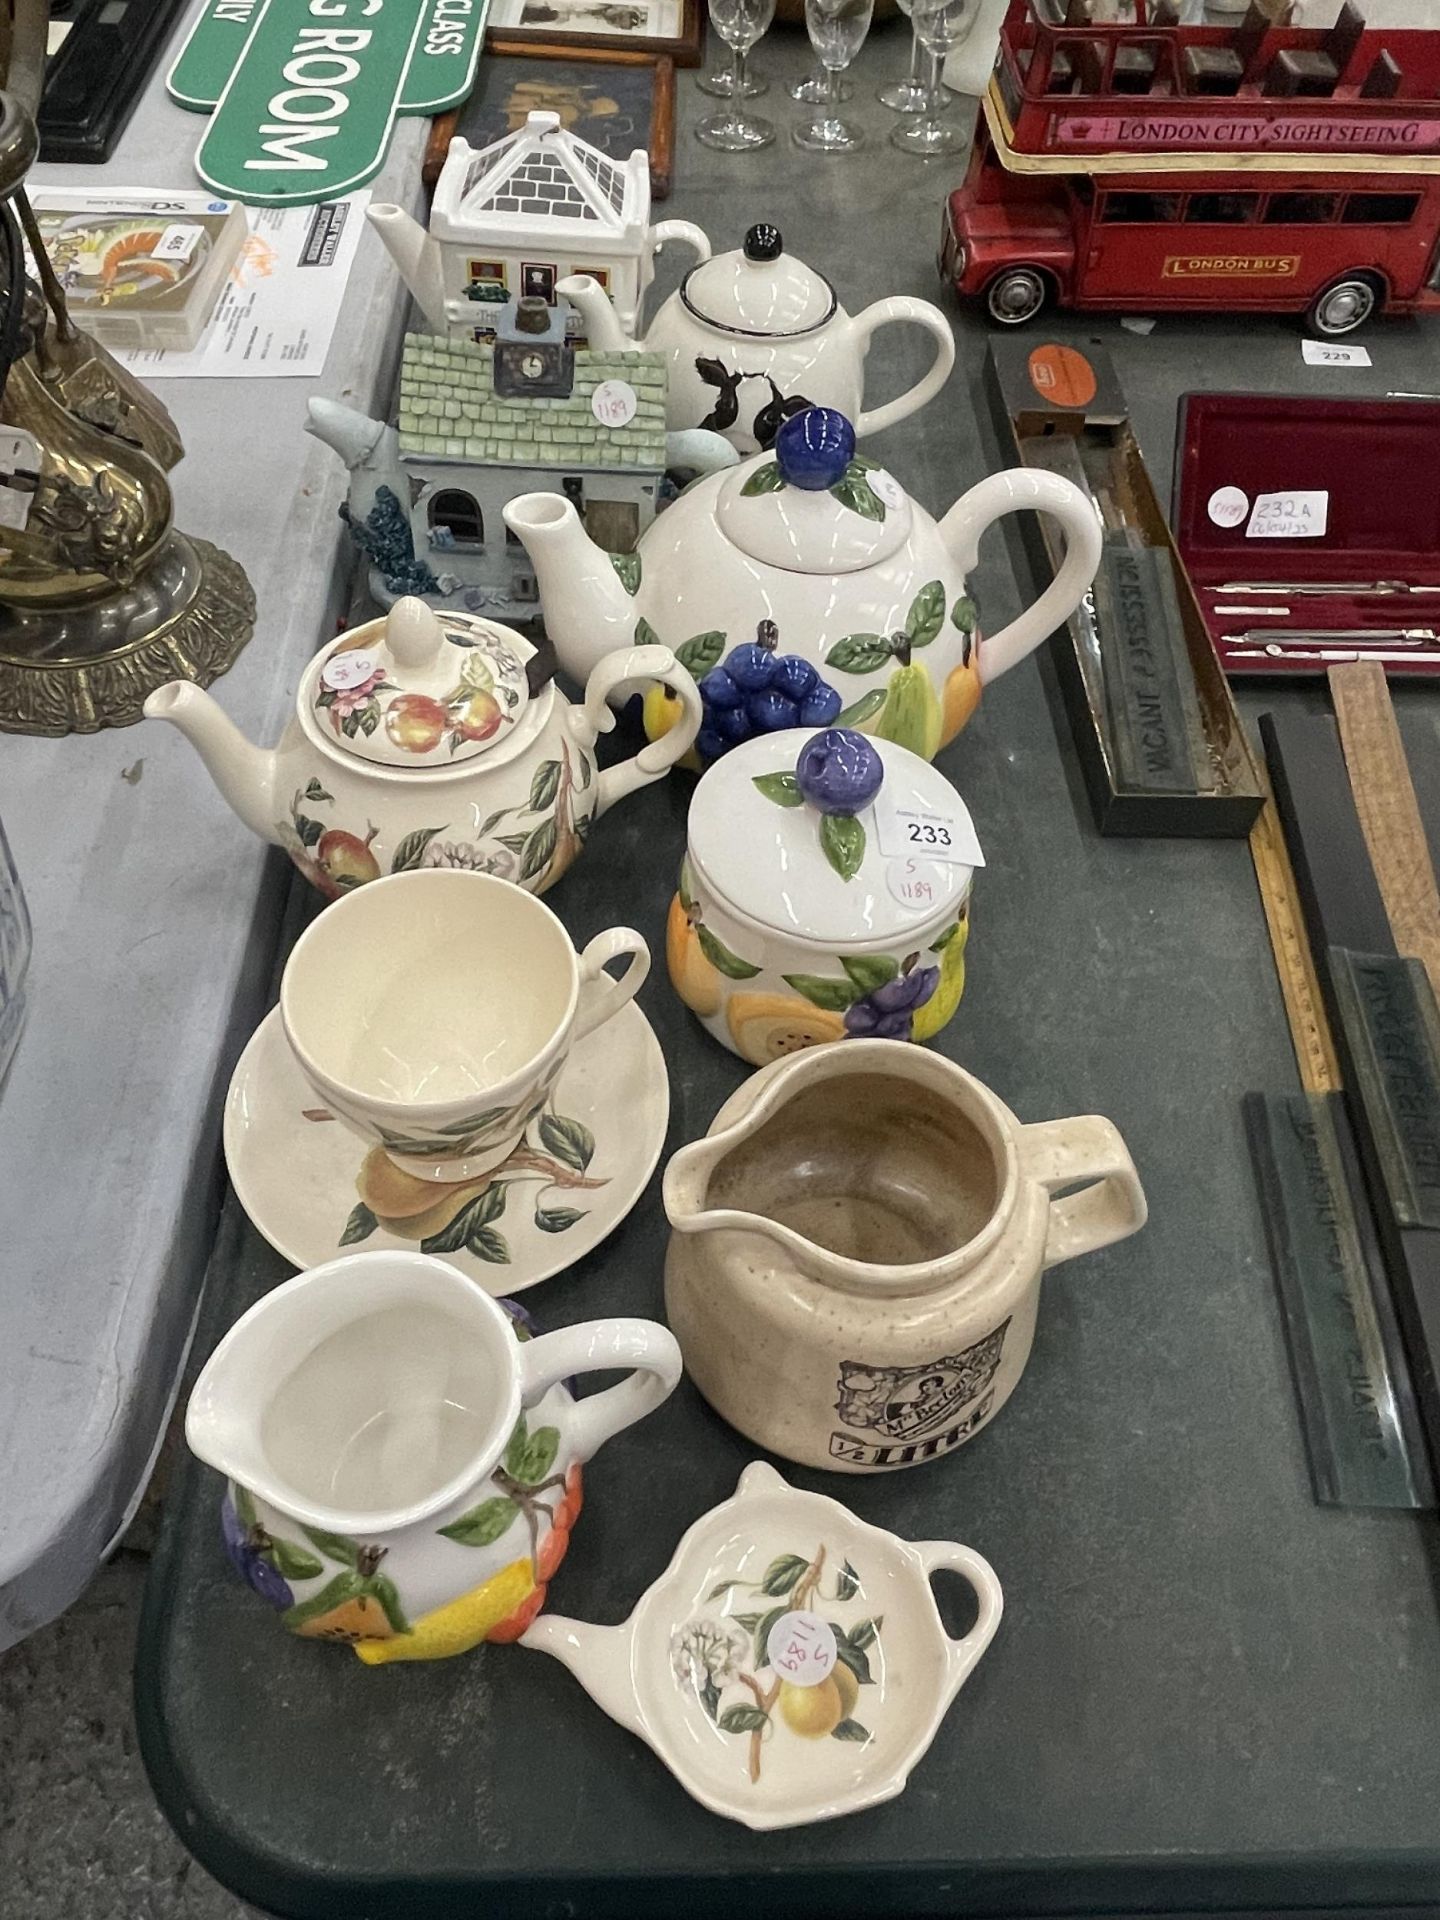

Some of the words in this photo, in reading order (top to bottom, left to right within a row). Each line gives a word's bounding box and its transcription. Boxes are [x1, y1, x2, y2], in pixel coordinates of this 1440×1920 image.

[423, 0, 473, 54] CLASS
[243, 28, 374, 170] ROOM
[1117, 120, 1211, 141] LONDON
[1214, 122, 1266, 142] CITY
[1270, 122, 1420, 143] SIGHTSEEING
[151, 201, 186, 211] DS
[1173, 259, 1249, 273] LONDON
[1253, 258, 1291, 272] BUS
[1321, 351, 1351, 361] 229
[597, 399, 628, 419] 1189
[907, 823, 952, 846] 233
[905, 858, 917, 874] S
[901, 882, 934, 902] 1189
[777, 1619, 817, 1673] 1189
